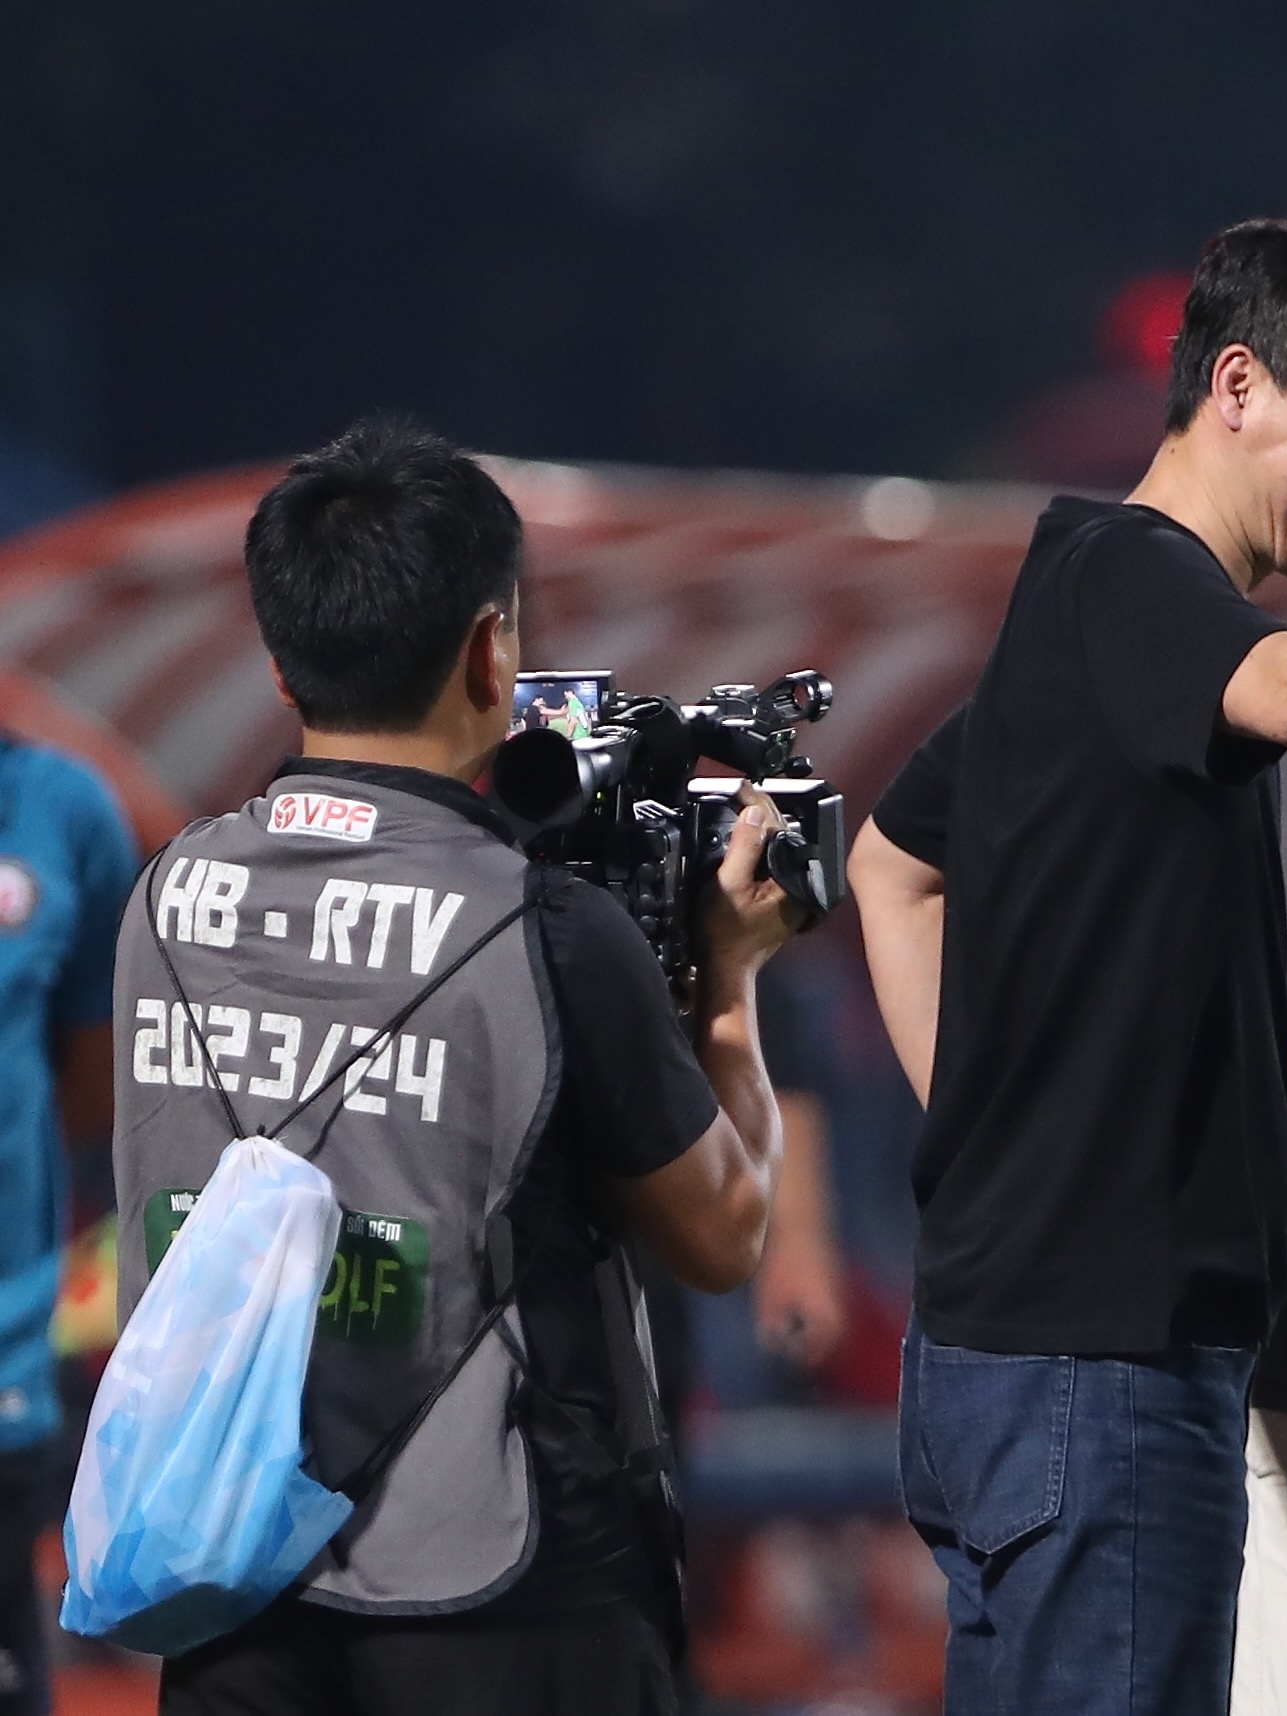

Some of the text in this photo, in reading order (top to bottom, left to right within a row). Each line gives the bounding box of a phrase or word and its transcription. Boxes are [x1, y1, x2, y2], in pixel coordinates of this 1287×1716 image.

[304, 796, 372, 831] VPF
[156, 858, 250, 949] HB
[309, 878, 464, 975] RTV
[132, 998, 447, 1122] 2023/24
[318, 1251, 400, 1322] OLF
